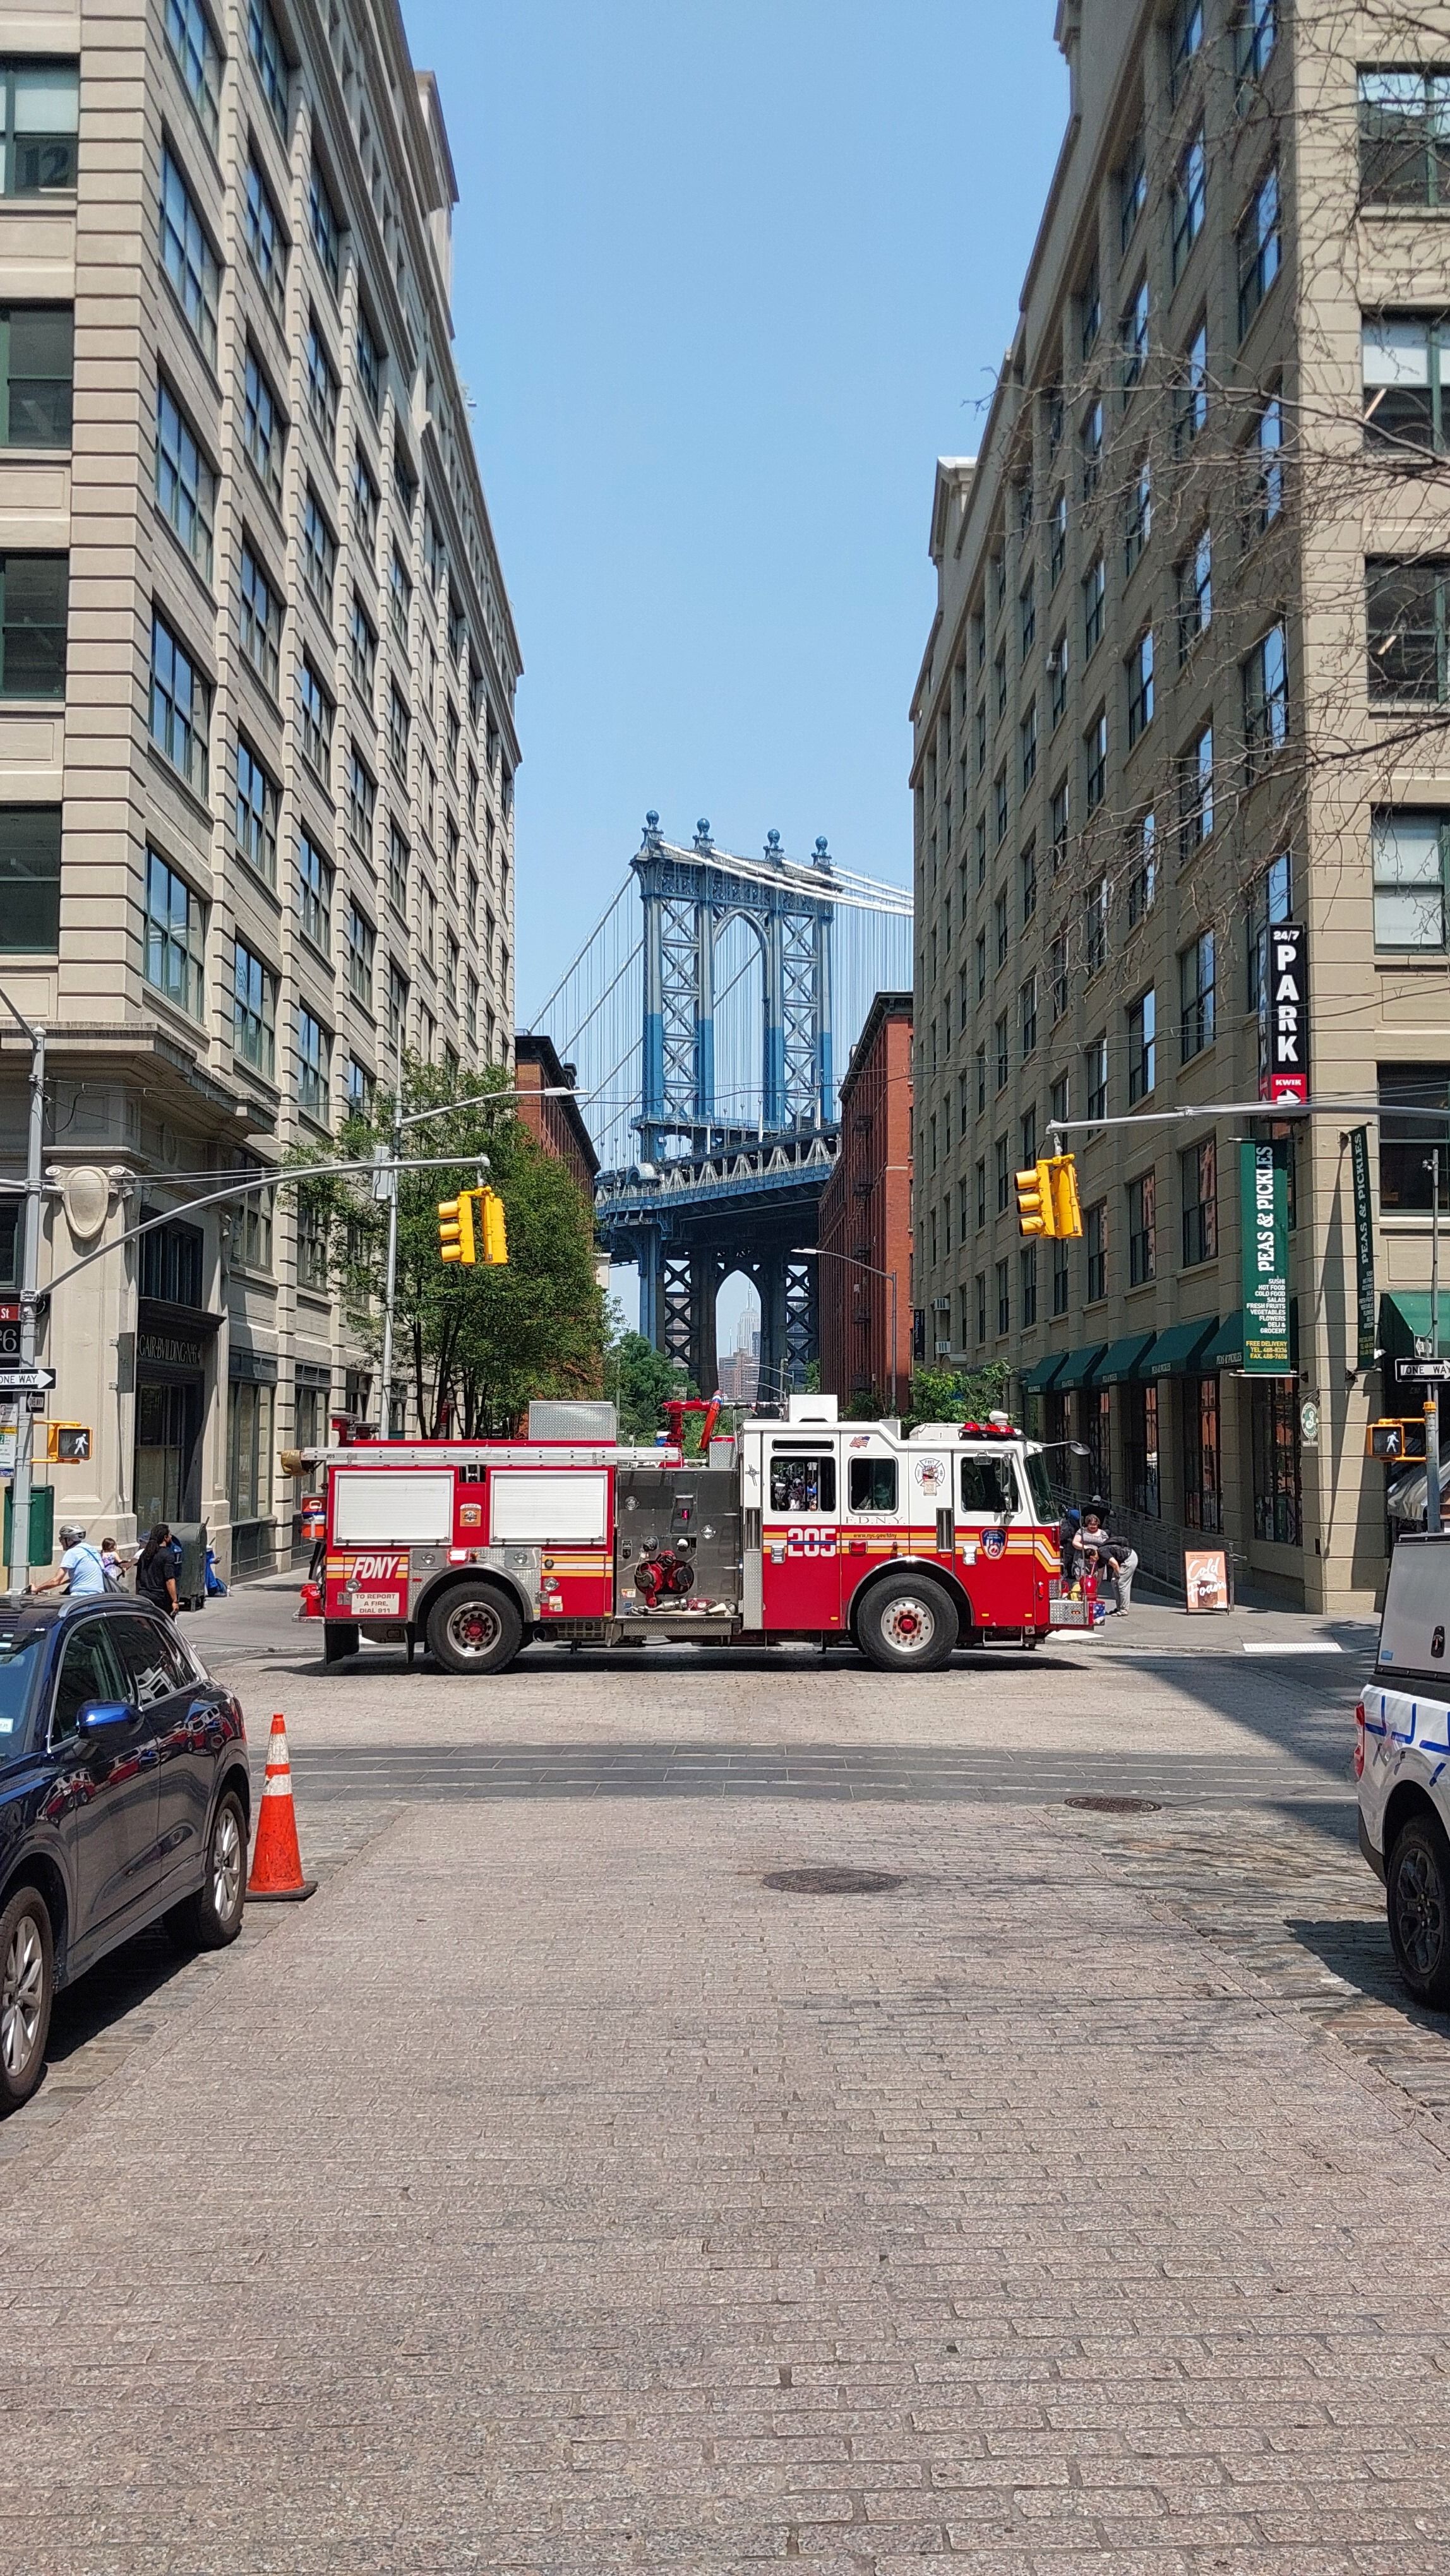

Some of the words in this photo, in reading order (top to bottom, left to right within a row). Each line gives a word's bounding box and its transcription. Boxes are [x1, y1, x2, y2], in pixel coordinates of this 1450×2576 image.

[25, 146, 68, 187] 12
[1273, 931, 1300, 942] 24/7
[1276, 945, 1300, 1061] PARK
[1256, 1146, 1274, 1210] PICKLES
[1355, 1133, 1366, 1200] PICKLES
[1257, 1213, 1274, 1227] &
[1257, 1232, 1274, 1272] PEAS
[1360, 1222, 1369, 1264] PEAS
[1406, 1366, 1425, 1374] ONE
[844, 1516, 906, 1525] F.D.N.Y.
[788, 1528, 836, 1557] 205
[351, 1556, 400, 1579] FDNY
[1187, 1557, 1221, 1581] Cold
[1187, 1580, 1226, 1603] Foam
